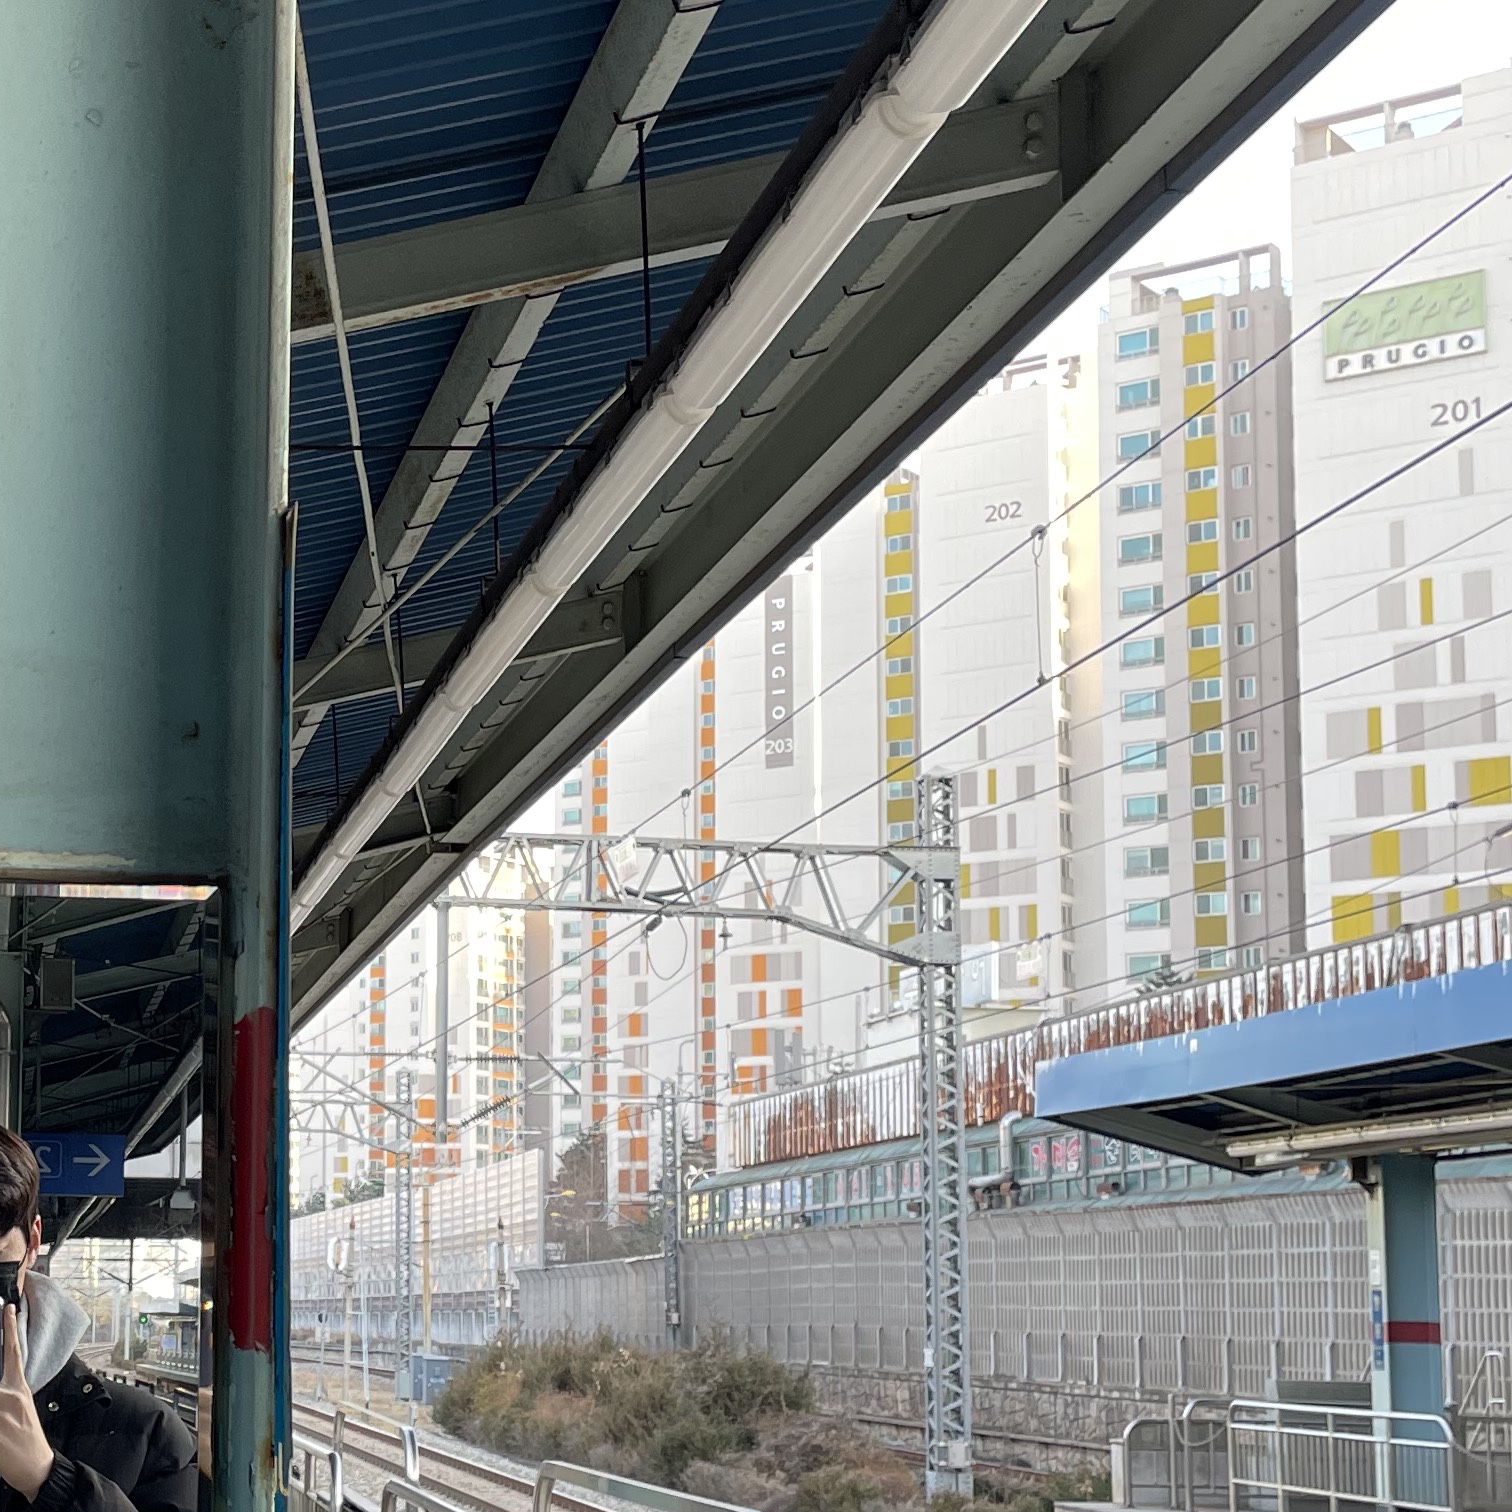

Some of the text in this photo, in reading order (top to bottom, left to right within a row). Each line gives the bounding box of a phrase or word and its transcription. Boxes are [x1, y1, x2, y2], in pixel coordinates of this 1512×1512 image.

[1337, 334, 1475, 374] PRUGIO
[1430, 396, 1482, 428] 201
[985, 501, 1022, 523] 202
[771, 598, 786, 720] PRUGIO
[765, 738, 794, 755] 203
